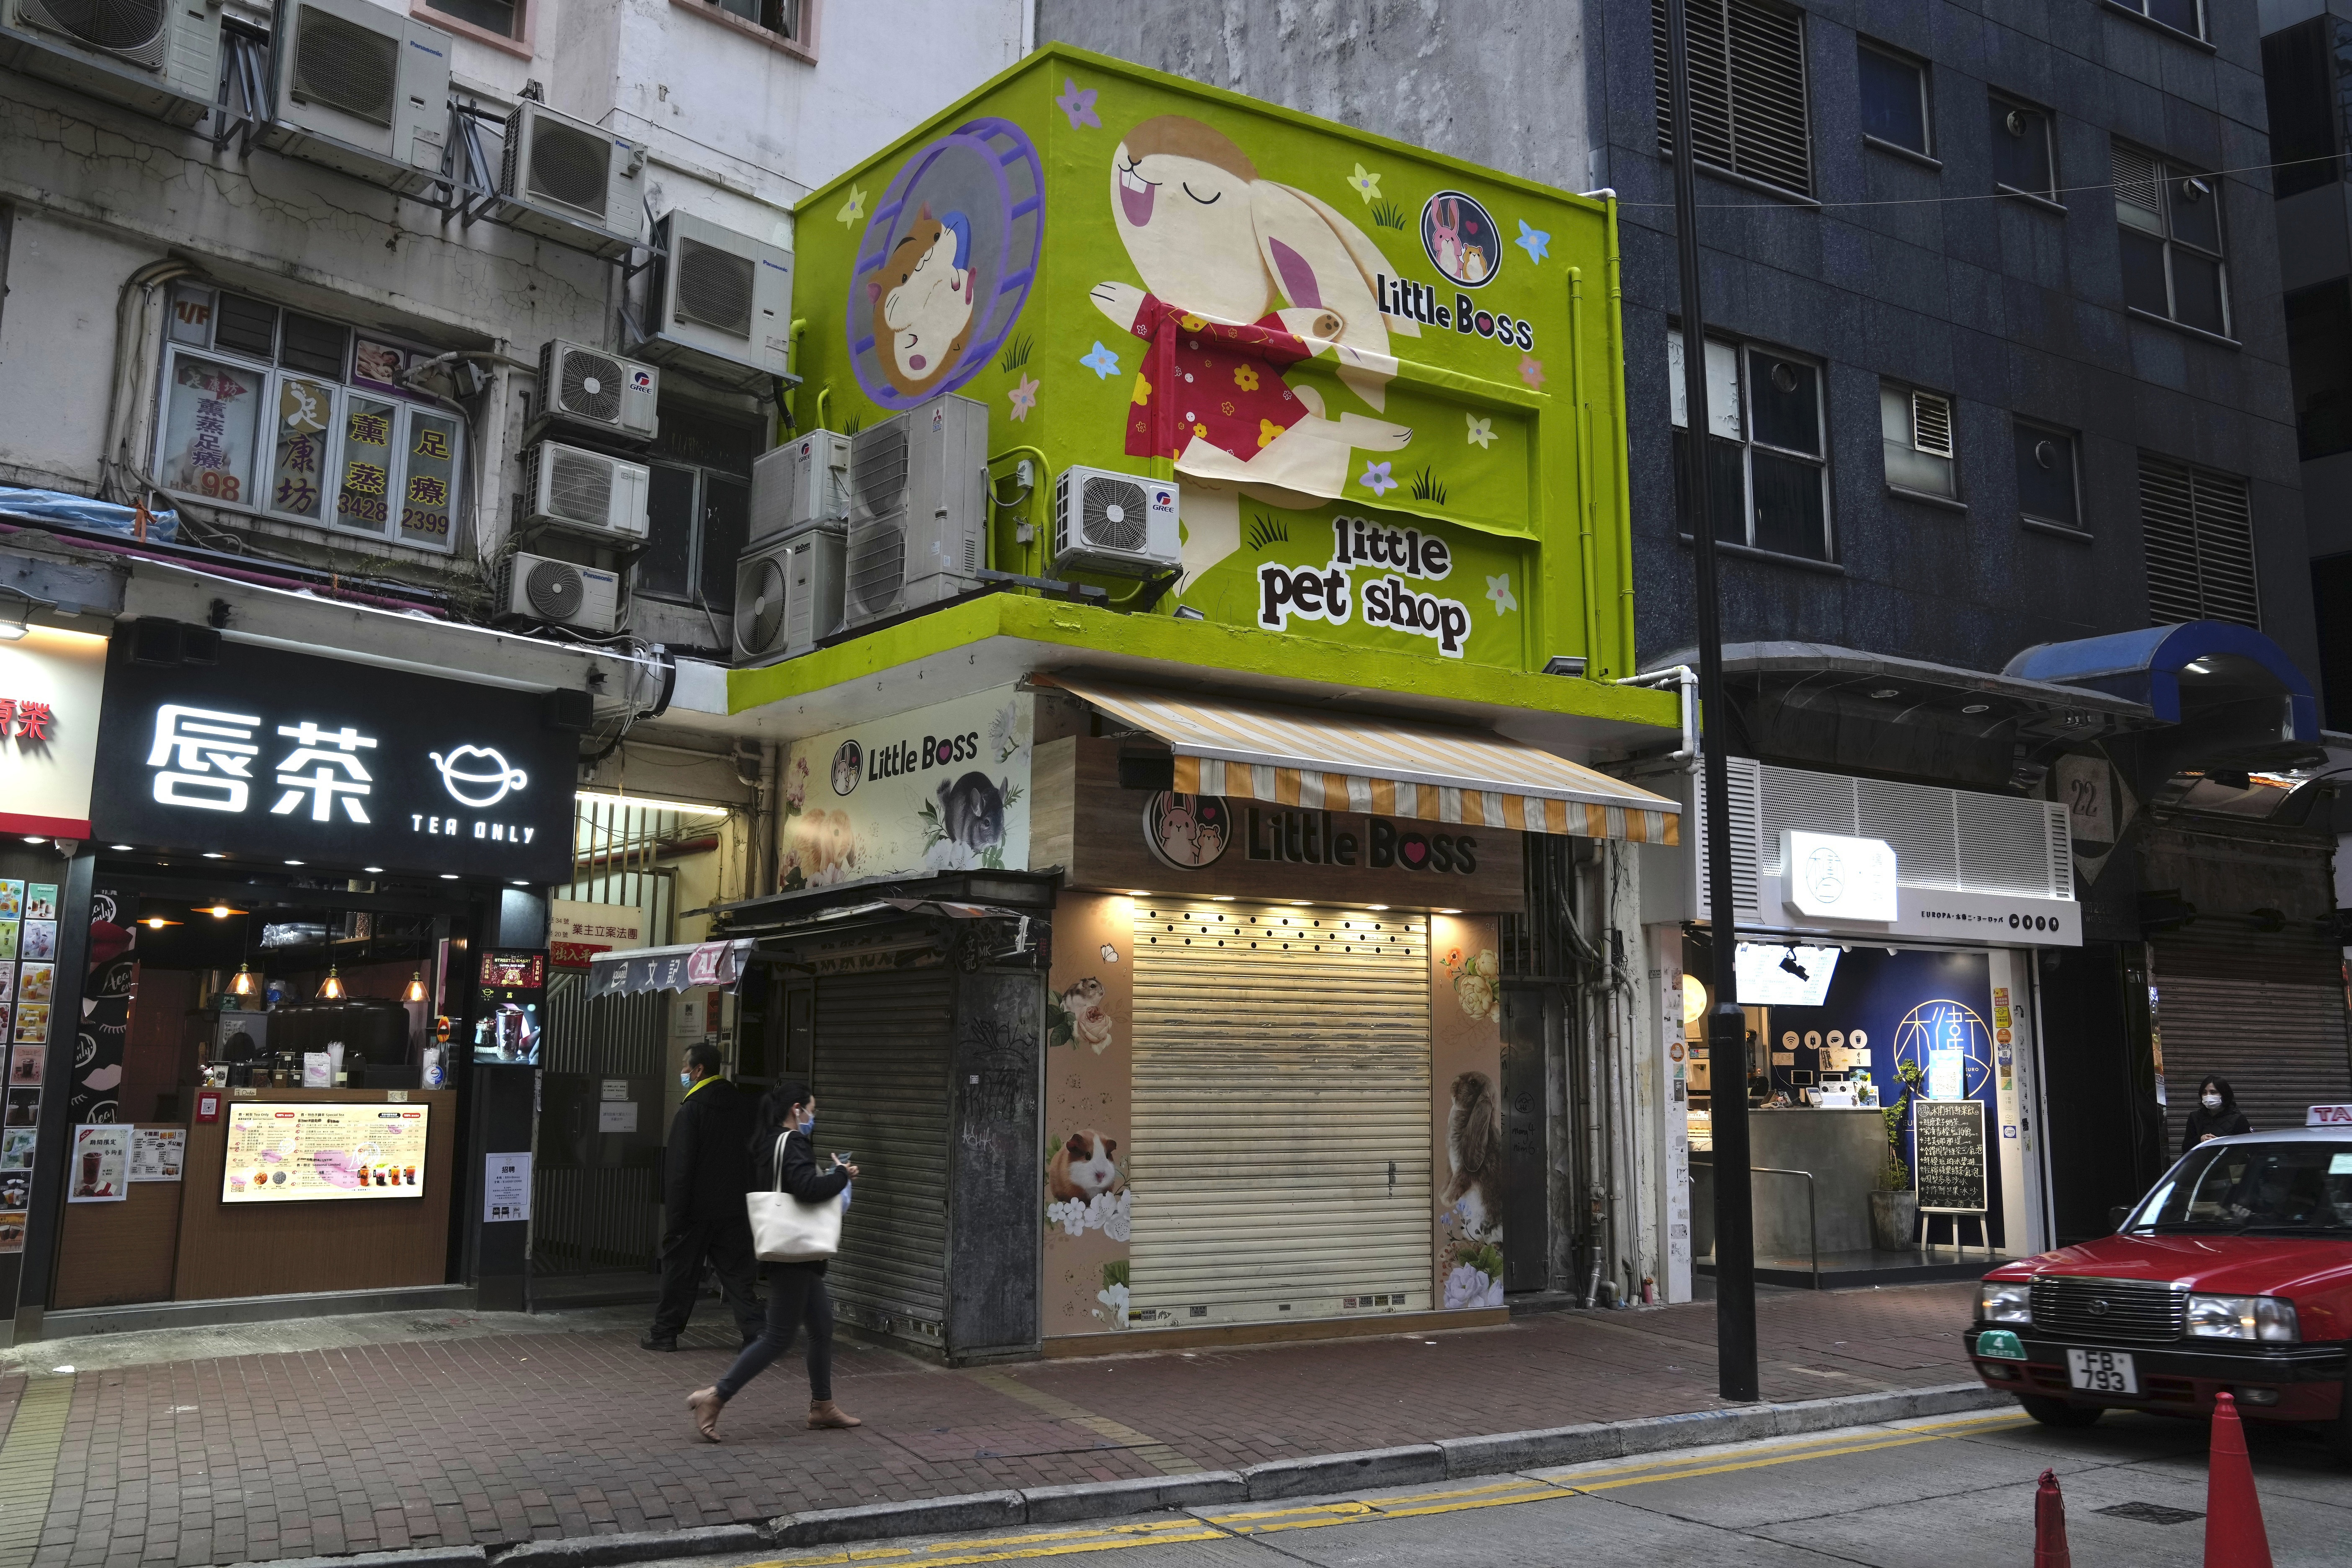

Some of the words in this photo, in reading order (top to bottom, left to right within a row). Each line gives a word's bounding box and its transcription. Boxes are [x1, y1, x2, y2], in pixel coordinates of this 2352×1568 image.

[410, 40, 442, 57] Panasonic
[763, 259, 788, 272] Panasonic
[176, 300, 211, 325] 1/F
[1377, 273, 1452, 329] Little
[1455, 292, 1533, 352] Boss
[629, 384, 652, 395] GREE
[410, 429, 451, 506] 足療
[799, 454, 811, 463] GREE
[170, 480, 198, 493] HK$
[201, 471, 240, 502] 98
[337, 493, 388, 523] 3428
[402, 508, 450, 535] 2399
[1153, 504, 1174, 513] GREE
[795, 542, 810, 552] McQuay
[1334, 517, 1450, 576] little
[583, 571, 613, 583] Panasonic
[1261, 567, 1347, 626] pet
[1364, 578, 1467, 652] shop
[146, 704, 377, 823] 唇茶
[868, 740, 917, 781] Little
[922, 732, 979, 770] Boss
[2071, 779, 2097, 817] 22
[413, 815, 457, 836] TEA
[475, 822, 534, 844] ONLY
[1244, 808, 1358, 866] Little
[1365, 818, 1477, 875] Boss
[573, 923, 637, 939] 業主立案法團
[1485, 923, 1495, 931] 34
[556, 947, 607, 963] 出入平
[979, 945, 992, 957] MK
[612, 967, 627, 979] AQUARIUS
[645, 959, 681, 985] 文記
[81, 1130, 89, 1140] NEW
[1993, 1337, 2005, 1349] 4
[1985, 1349, 2017, 1357] SEATS
[2084, 1351, 2114, 1371] FB
[2080, 1369, 2125, 1391] 793
